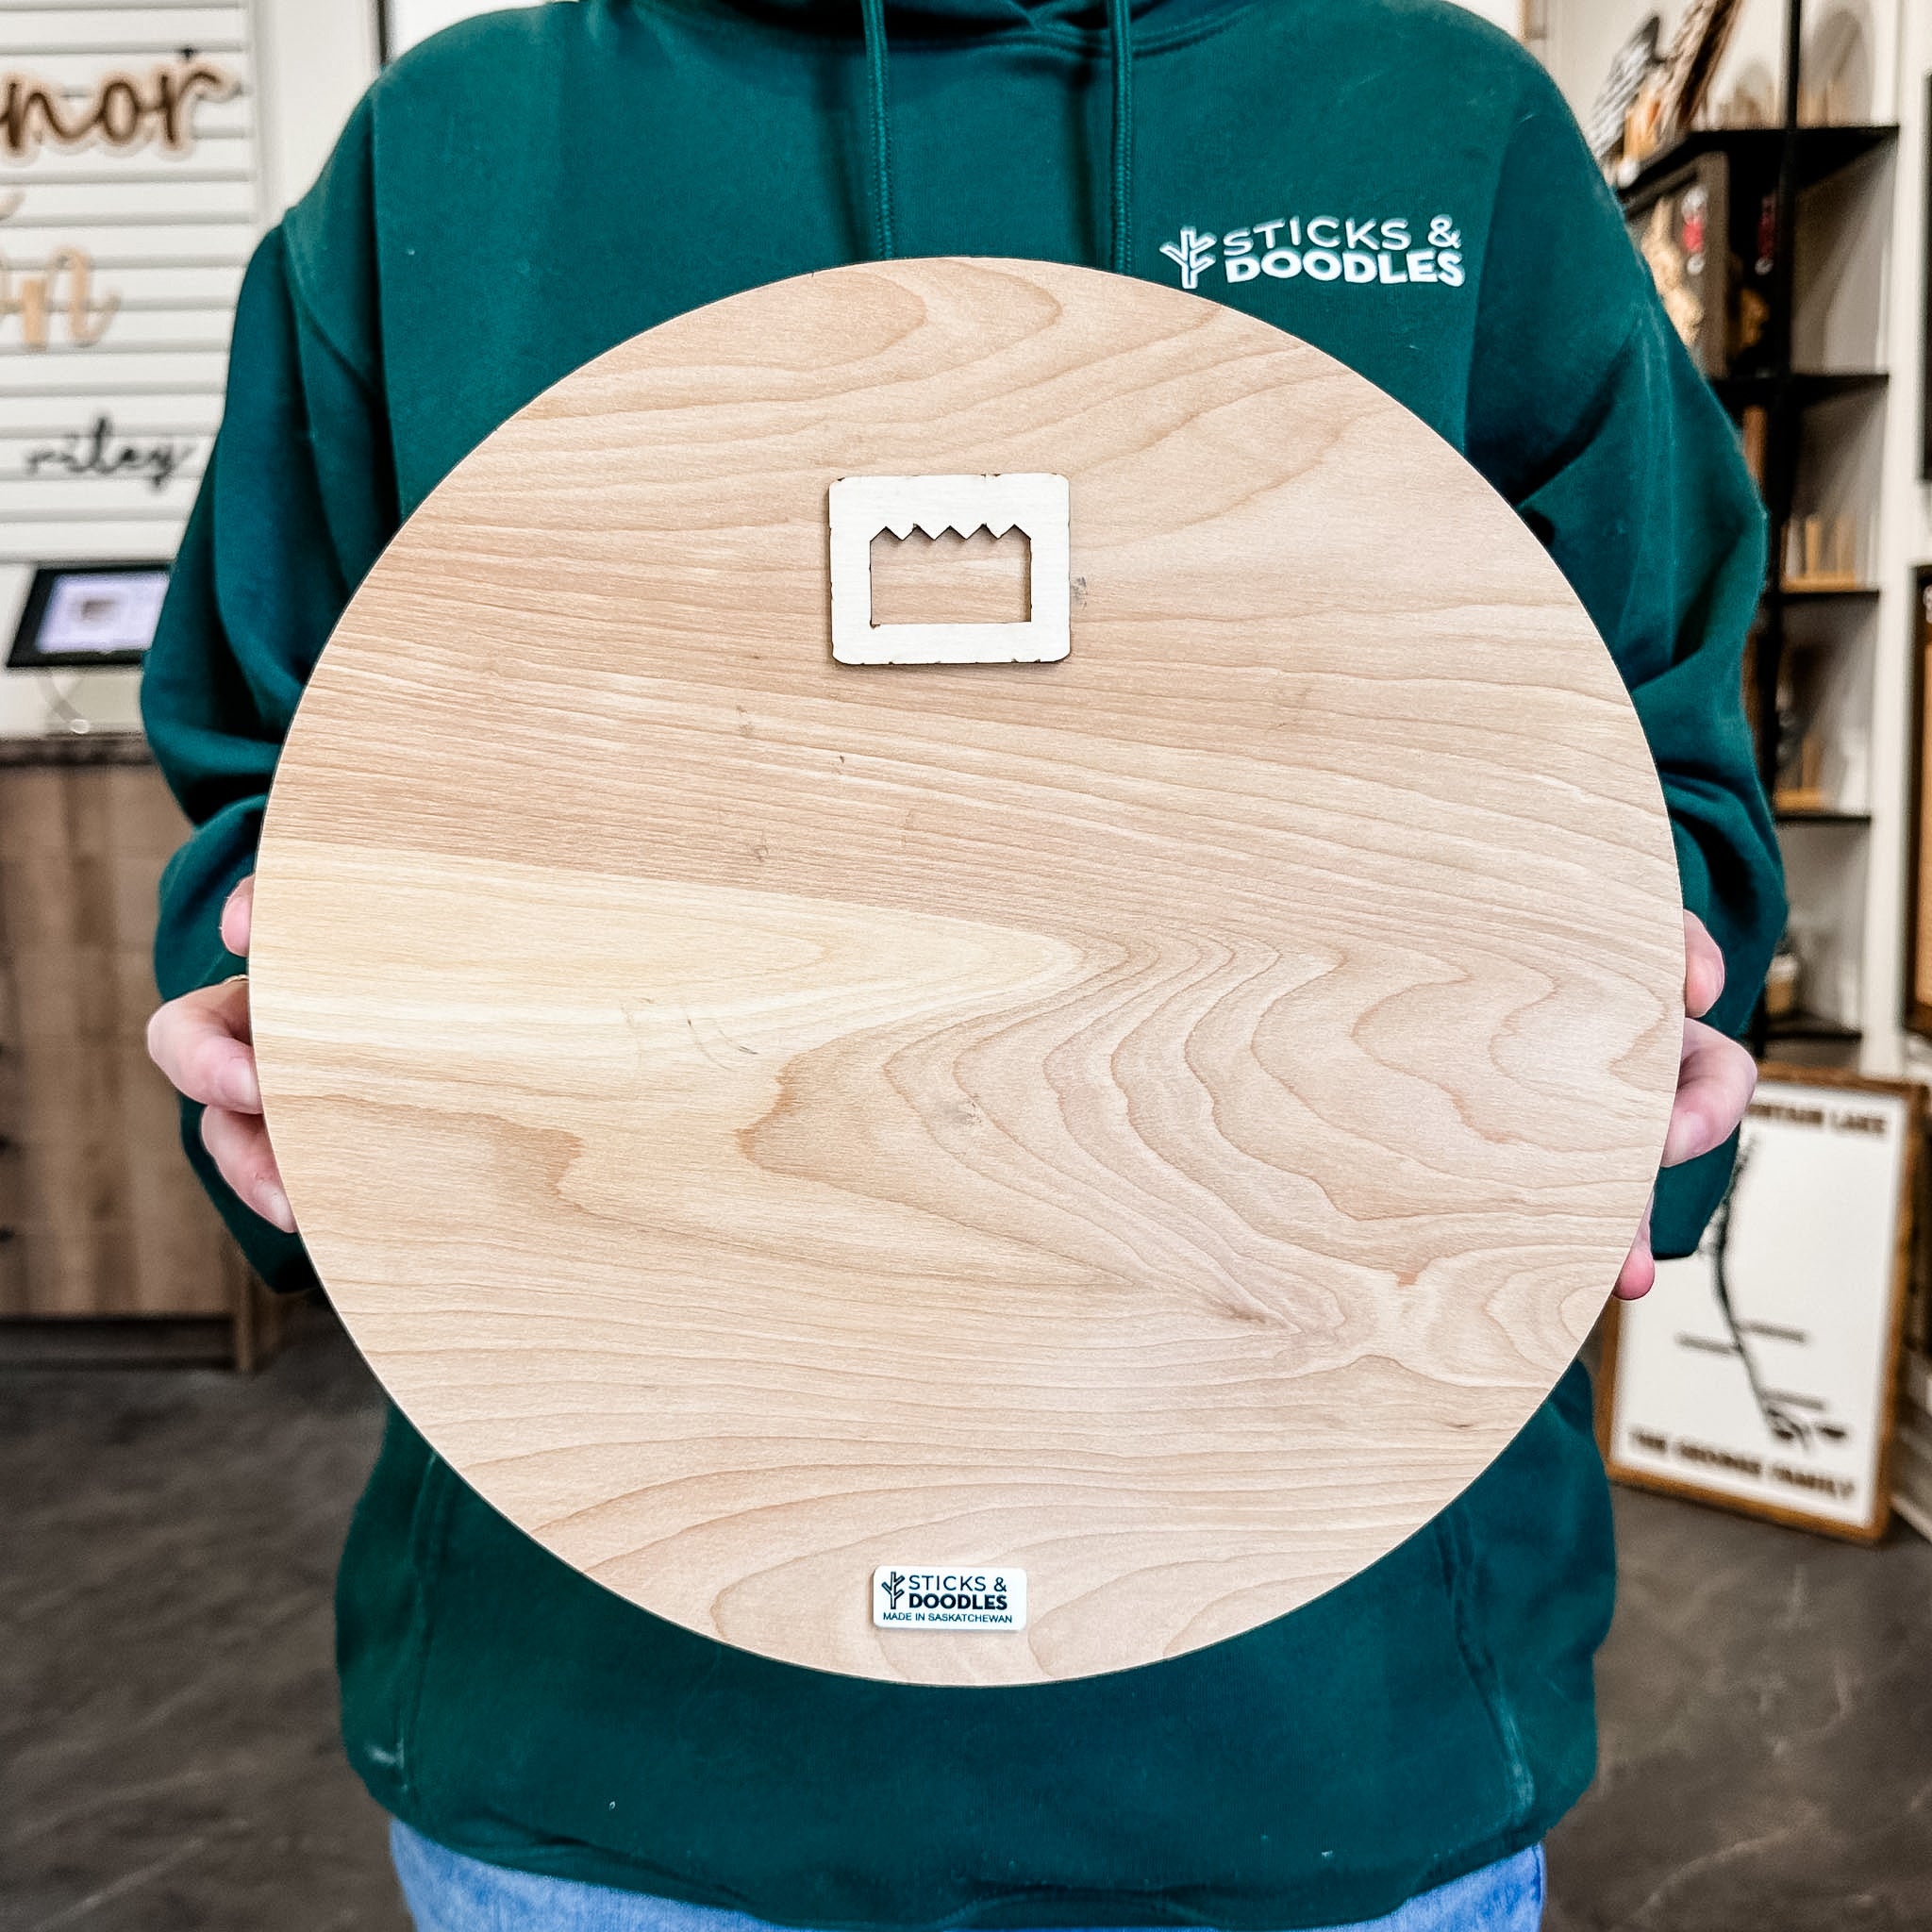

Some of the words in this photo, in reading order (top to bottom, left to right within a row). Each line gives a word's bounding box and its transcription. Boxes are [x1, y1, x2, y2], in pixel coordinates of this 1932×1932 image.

[1224, 215, 1412, 256] STICKS
[1427, 213, 1462, 249] &
[1225, 247, 1466, 287] DOODLES
[908, 1574, 986, 1591] STICKS
[993, 1576, 1008, 1592] &
[908, 1592, 1008, 1610] DOODLES
[883, 1612, 911, 1621] MADE
[915, 1612, 924, 1621] IN
[927, 1612, 1012, 1624] SASKATCHEWAN
